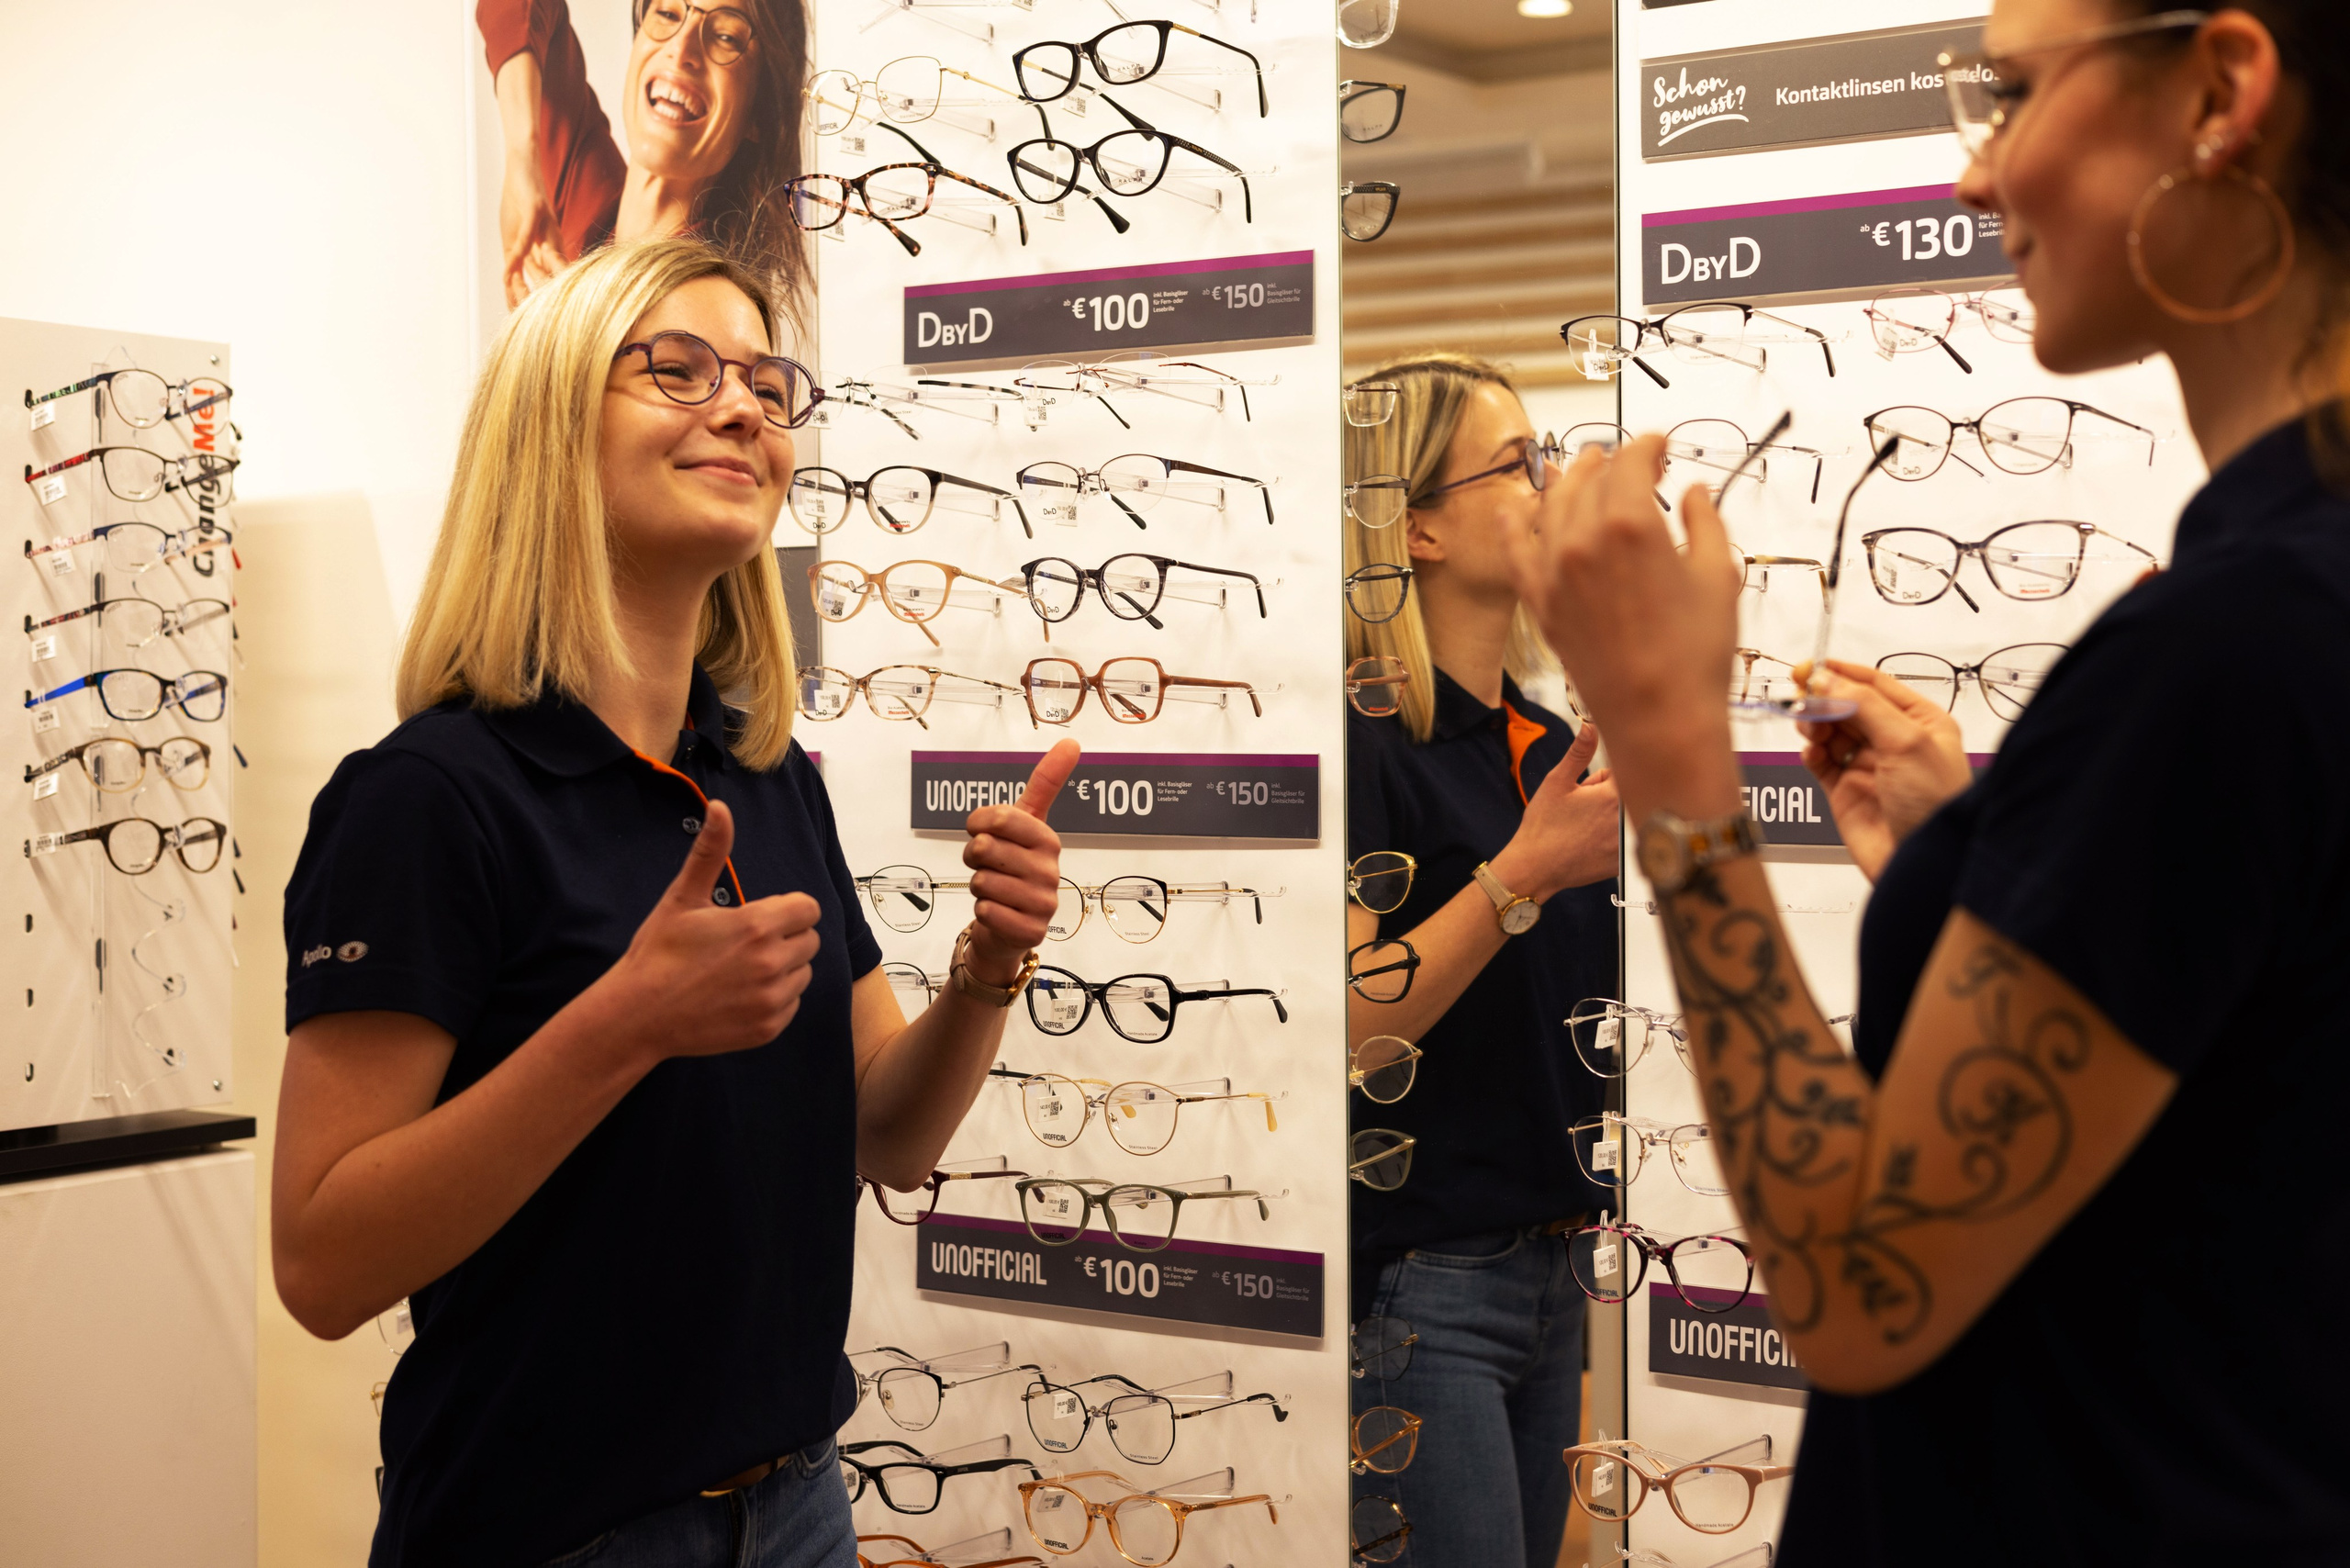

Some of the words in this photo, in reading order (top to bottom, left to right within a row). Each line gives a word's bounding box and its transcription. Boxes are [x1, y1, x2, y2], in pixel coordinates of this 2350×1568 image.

[1652, 67, 1729, 108] Schon
[1775, 77, 1905, 106] Kontaktlinsen
[1659, 85, 1747, 136] gewusst?
[1860, 224, 1870, 232] ab
[932, 1241, 1047, 1285] UNOFFICIAL
